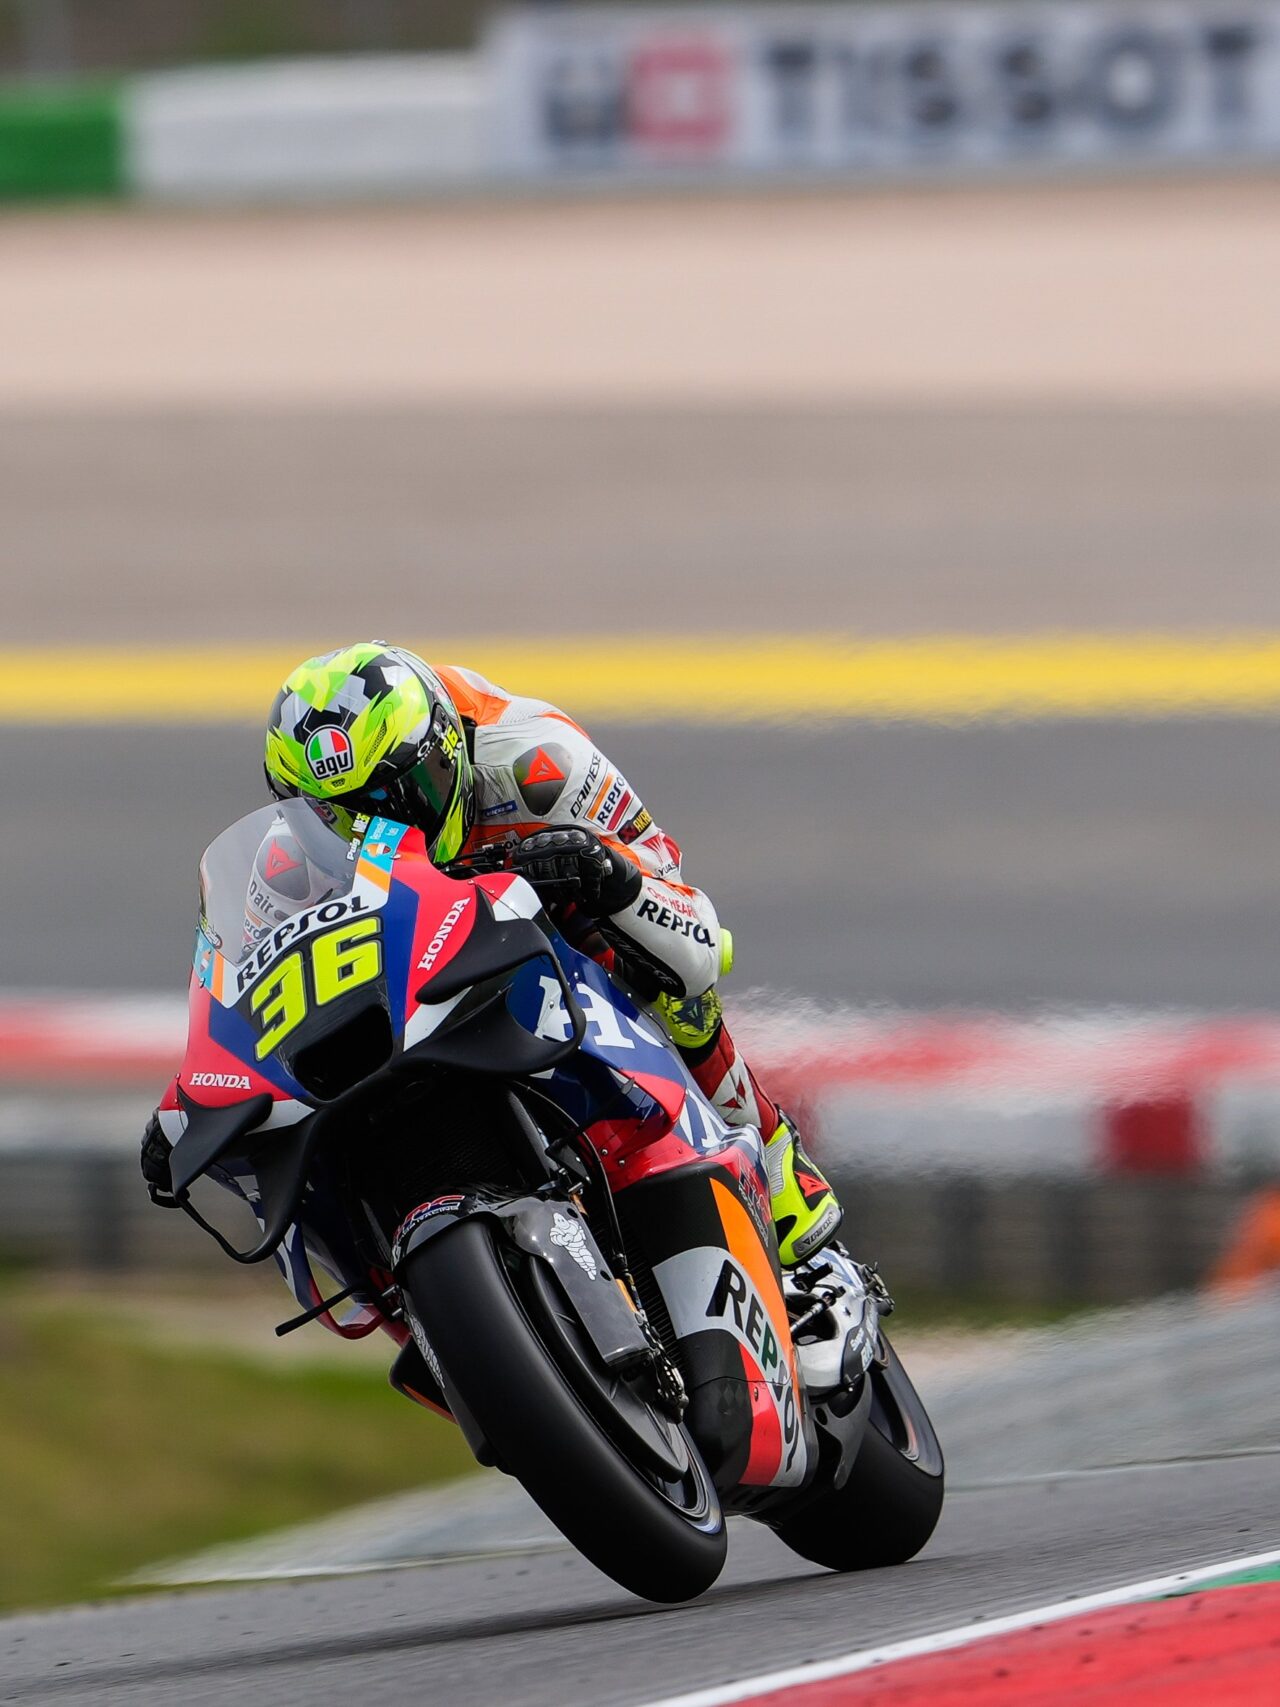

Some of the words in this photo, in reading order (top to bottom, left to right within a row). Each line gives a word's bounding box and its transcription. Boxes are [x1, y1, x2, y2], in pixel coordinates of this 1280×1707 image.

[765, 20, 1262, 132] TISSOT
[314, 752, 349, 777] agv
[570, 751, 601, 818] DAINESE
[346, 837, 361, 861] Puig
[236, 895, 369, 993] REPSOL
[417, 897, 470, 971] HONDA
[637, 898, 716, 948] REPSOL
[251, 917, 382, 1062] 36
[189, 1072, 252, 1090] HONDA
[705, 1259, 799, 1473] REPSOL
